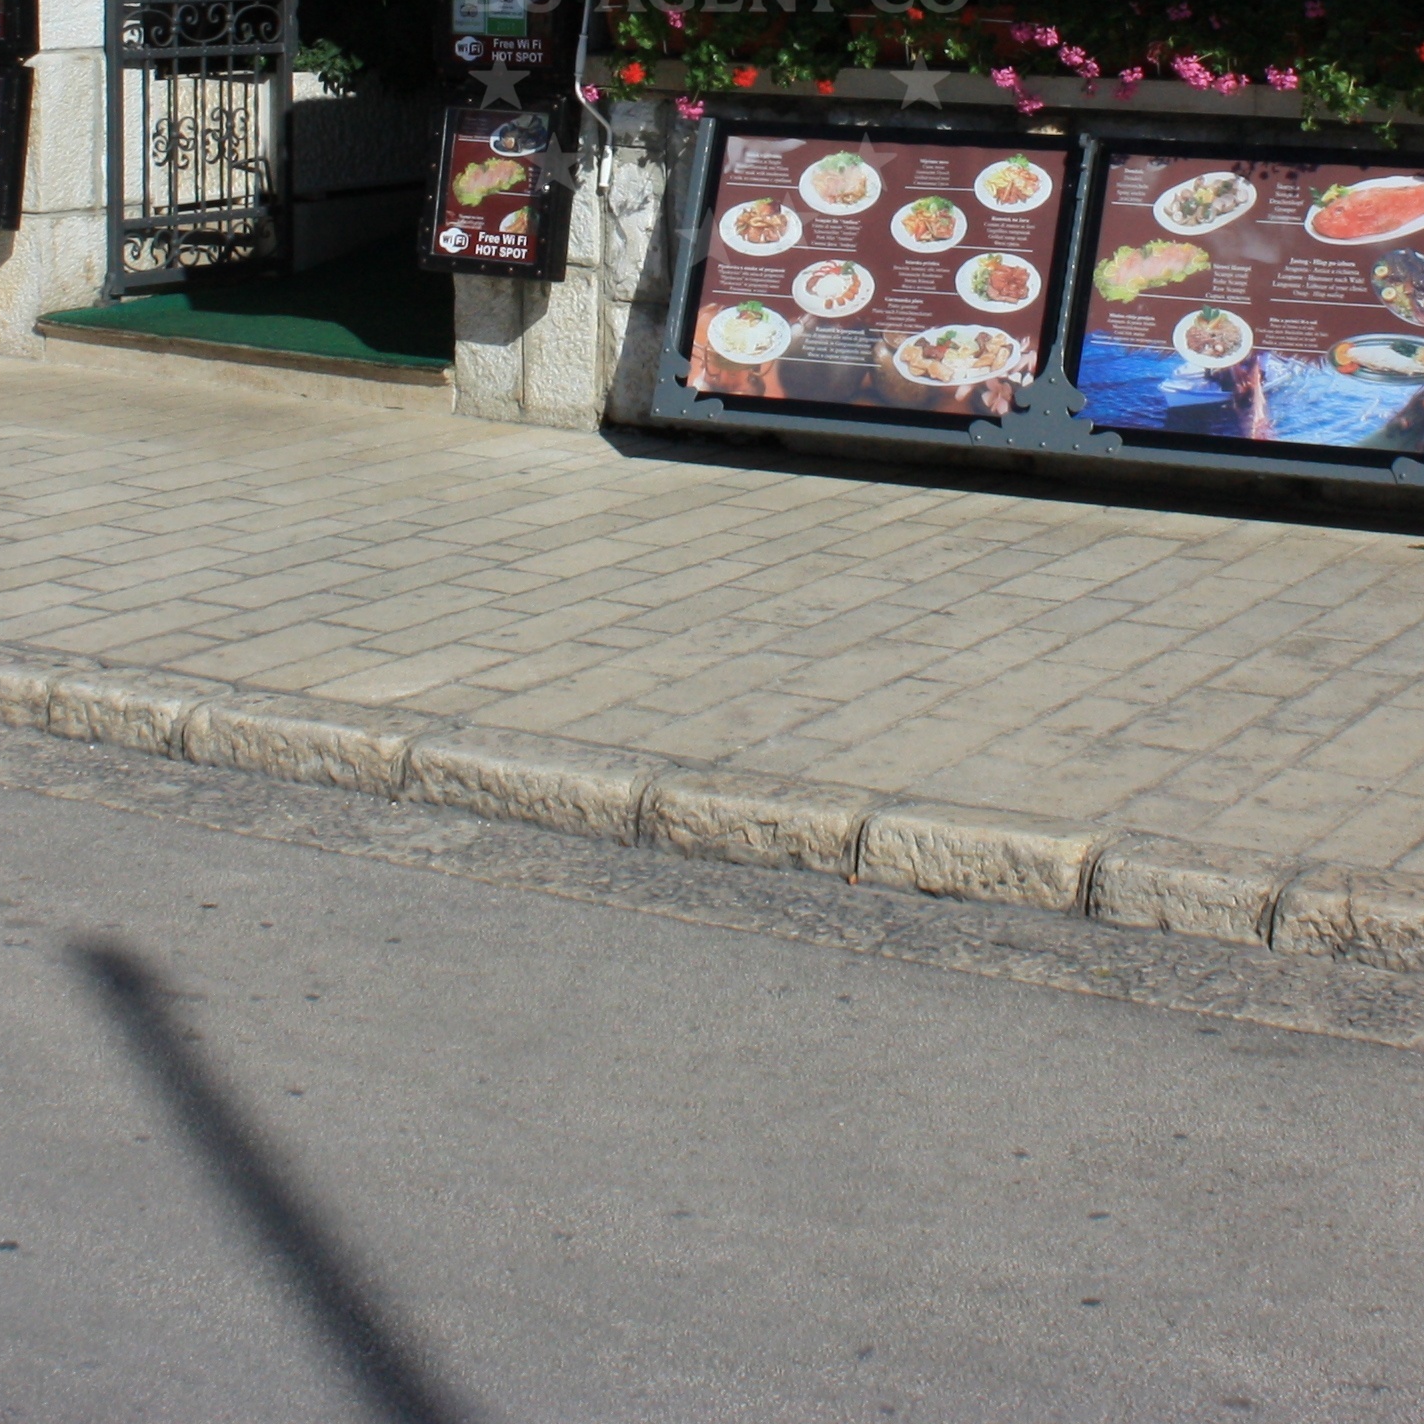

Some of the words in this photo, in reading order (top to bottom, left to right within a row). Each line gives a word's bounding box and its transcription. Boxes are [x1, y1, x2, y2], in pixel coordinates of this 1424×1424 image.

[493, 38, 515, 49] Free
[517, 39, 530, 49] Wi
[532, 39, 542, 50] Fi
[491, 51, 514, 62] HOT
[515, 52, 544, 63] SPOT
[478, 232, 501, 244] Free
[502, 233, 516, 245] Wi
[517, 234, 528, 247] Fi
[475, 245, 498, 257] HOT
[498, 246, 528, 260] SPOT
